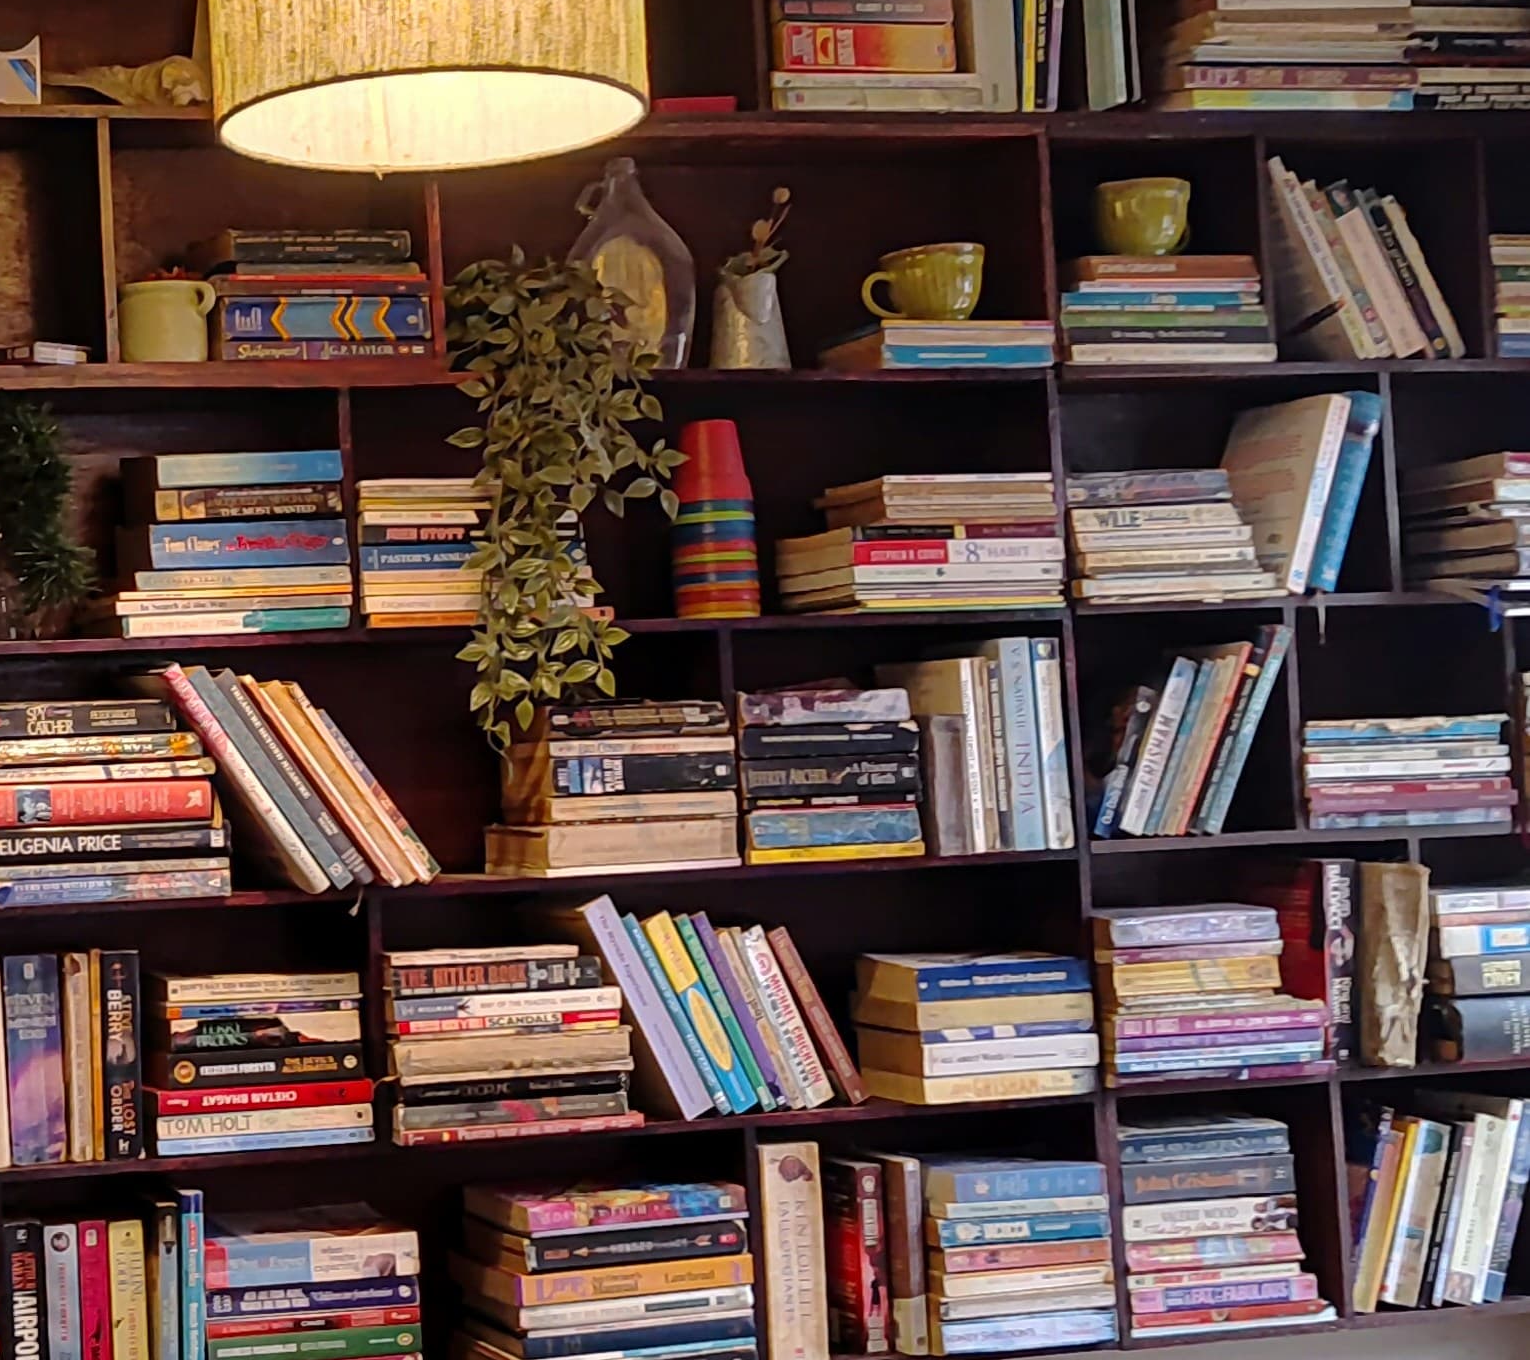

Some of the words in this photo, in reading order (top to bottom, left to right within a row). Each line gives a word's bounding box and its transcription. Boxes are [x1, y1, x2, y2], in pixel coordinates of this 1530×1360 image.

[25, 705, 47, 721] SPY
[26, 719, 74, 735] CATCHER
[77, 834, 122, 852] PRICE
[106, 989, 123, 1042] BERRY
[487, 1013, 560, 1028] SCANDALS
[769, 972, 797, 1023] MICHAEL
[789, 1025, 823, 1085] CRICHTON
[201, 1092, 249, 1108] BHAGAT
[251, 1090, 298, 1105] CHETAN
[110, 1084, 124, 1134] ORDER
[162, 1118, 207, 1137] TOM
[209, 1115, 254, 1135] HOLT
